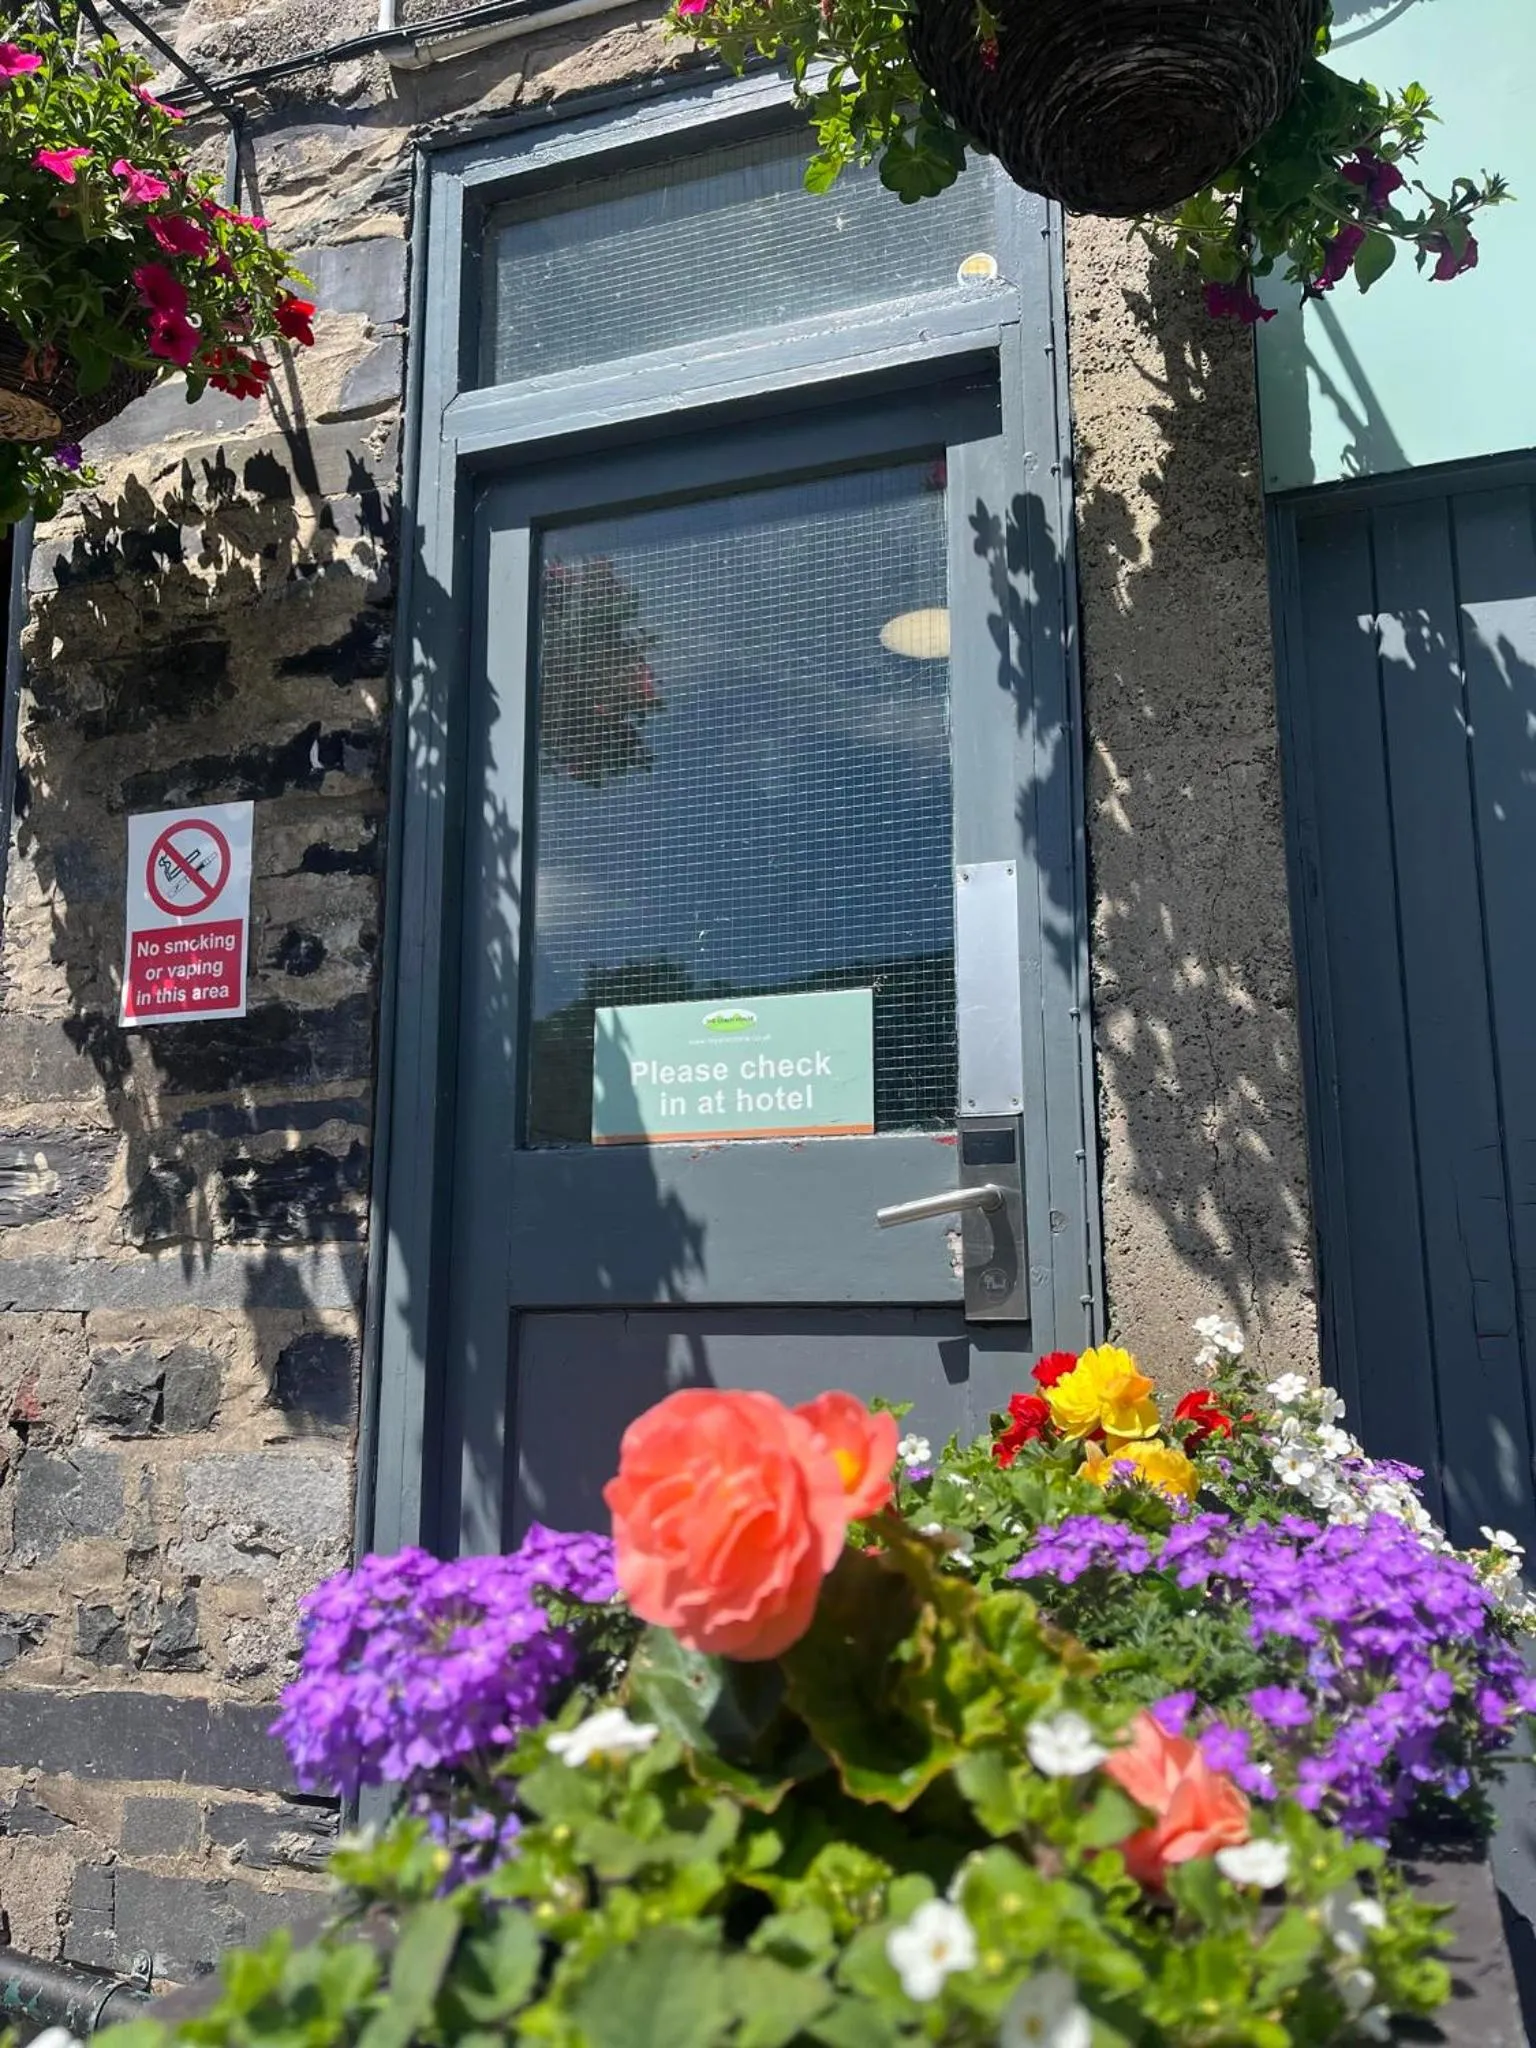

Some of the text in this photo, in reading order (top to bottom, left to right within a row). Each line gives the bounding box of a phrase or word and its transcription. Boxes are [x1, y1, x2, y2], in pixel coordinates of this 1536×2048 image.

[137, 933, 236, 957] No smoking
[145, 960, 224, 980] or vaping
[136, 985, 229, 1006] in this area
[630, 1050, 832, 1086] Please check
[660, 1085, 813, 1117] in at hotel
